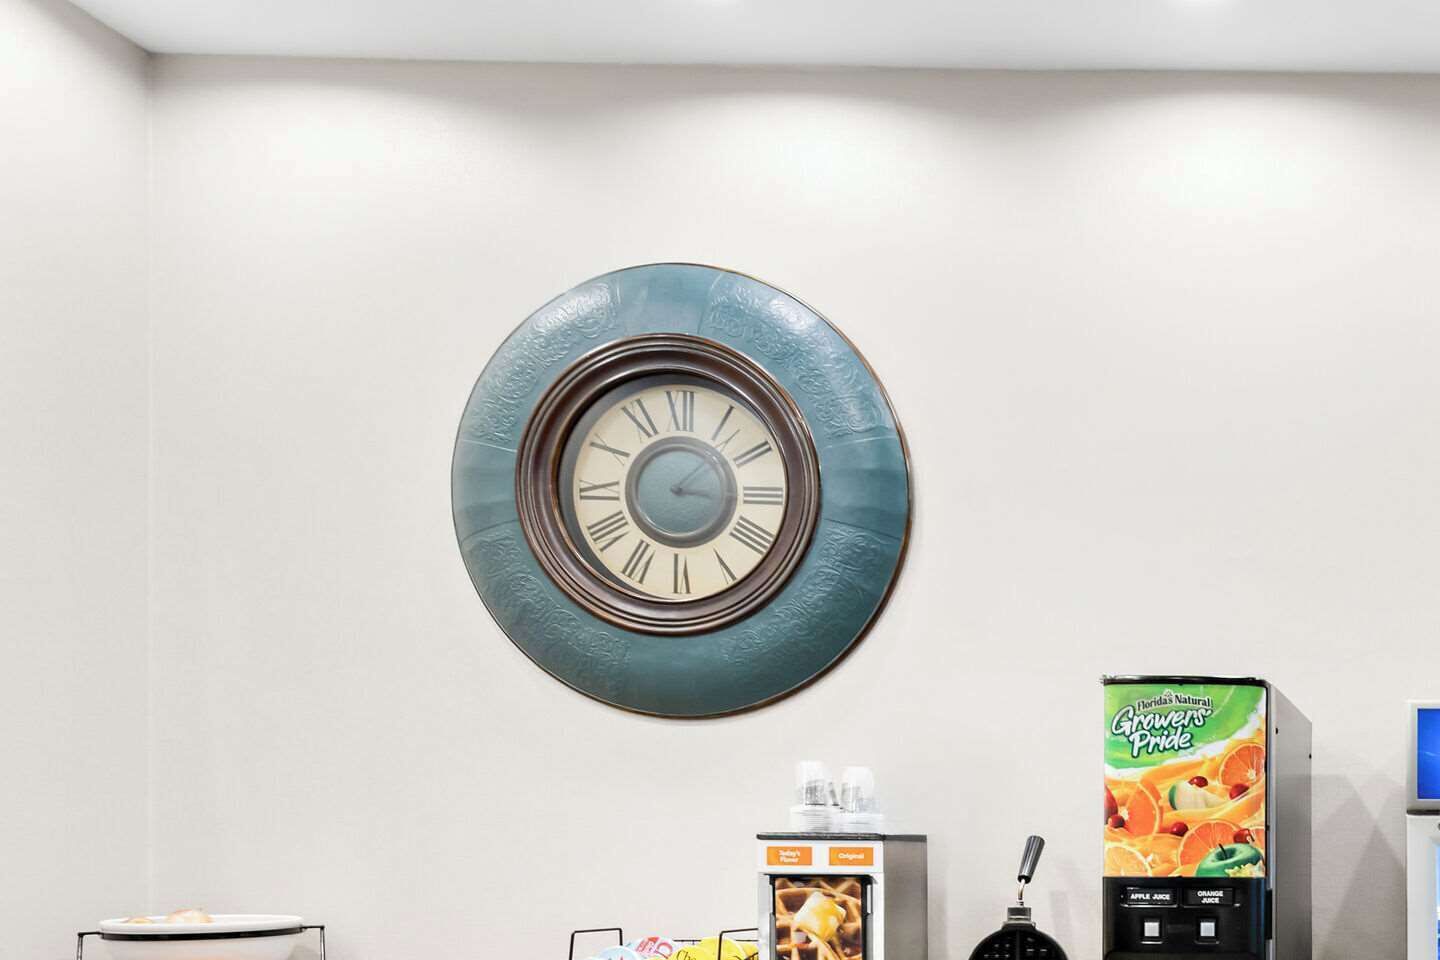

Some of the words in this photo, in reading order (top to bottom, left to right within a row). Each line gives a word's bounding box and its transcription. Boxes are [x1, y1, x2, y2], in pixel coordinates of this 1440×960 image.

[621, 398, 659, 444] XI
[665, 390, 695, 432] XII
[589, 433, 631, 466] X
[579, 479, 621, 501] IX
[742, 485, 784, 506] III
[712, 547, 738, 585] V
[1174, 693, 1212, 708] Natural
[1128, 725, 1193, 758] Pride
[838, 852, 865, 861] Original
